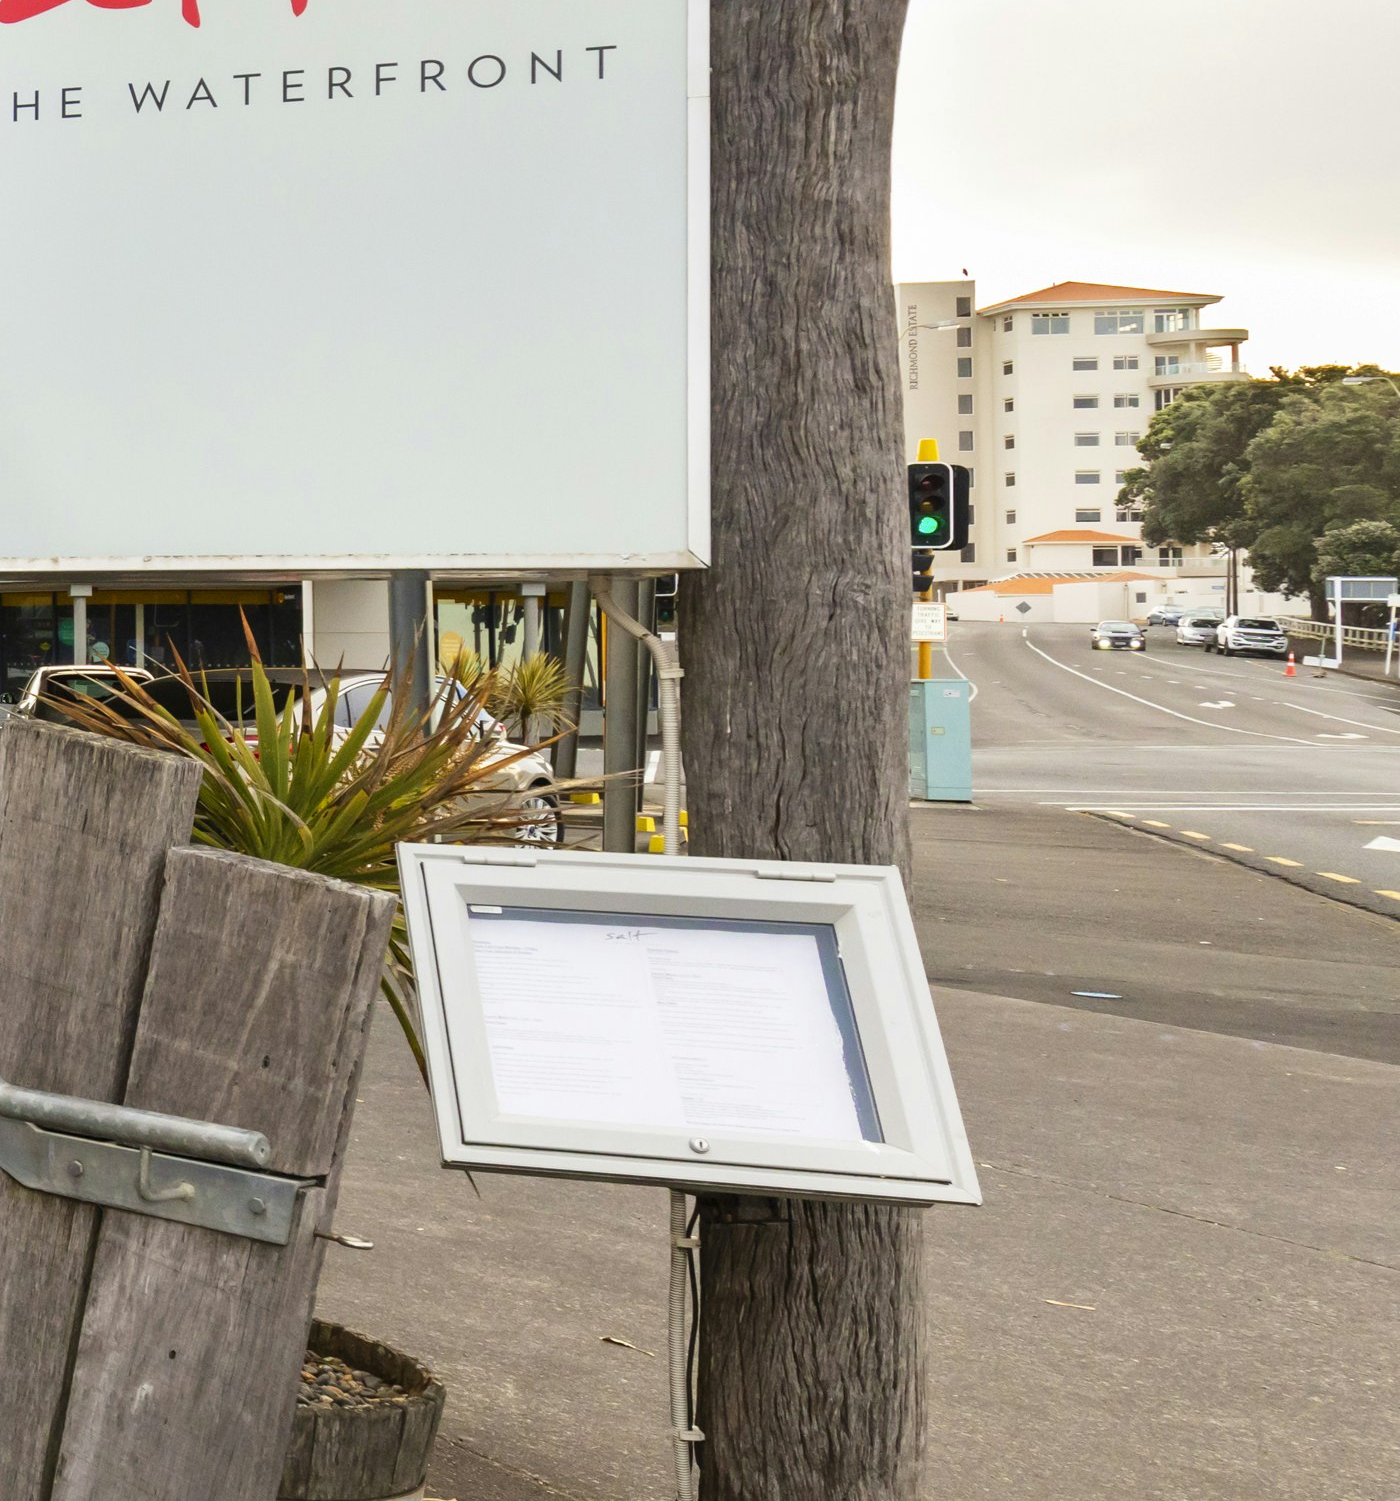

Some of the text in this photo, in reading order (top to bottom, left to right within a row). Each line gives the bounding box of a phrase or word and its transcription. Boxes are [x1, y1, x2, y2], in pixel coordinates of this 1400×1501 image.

[127, 44, 619, 114] WATERFRONT
[907, 304, 919, 390] RICHMOND ESTATE
[605, 930, 658, 941] salt
